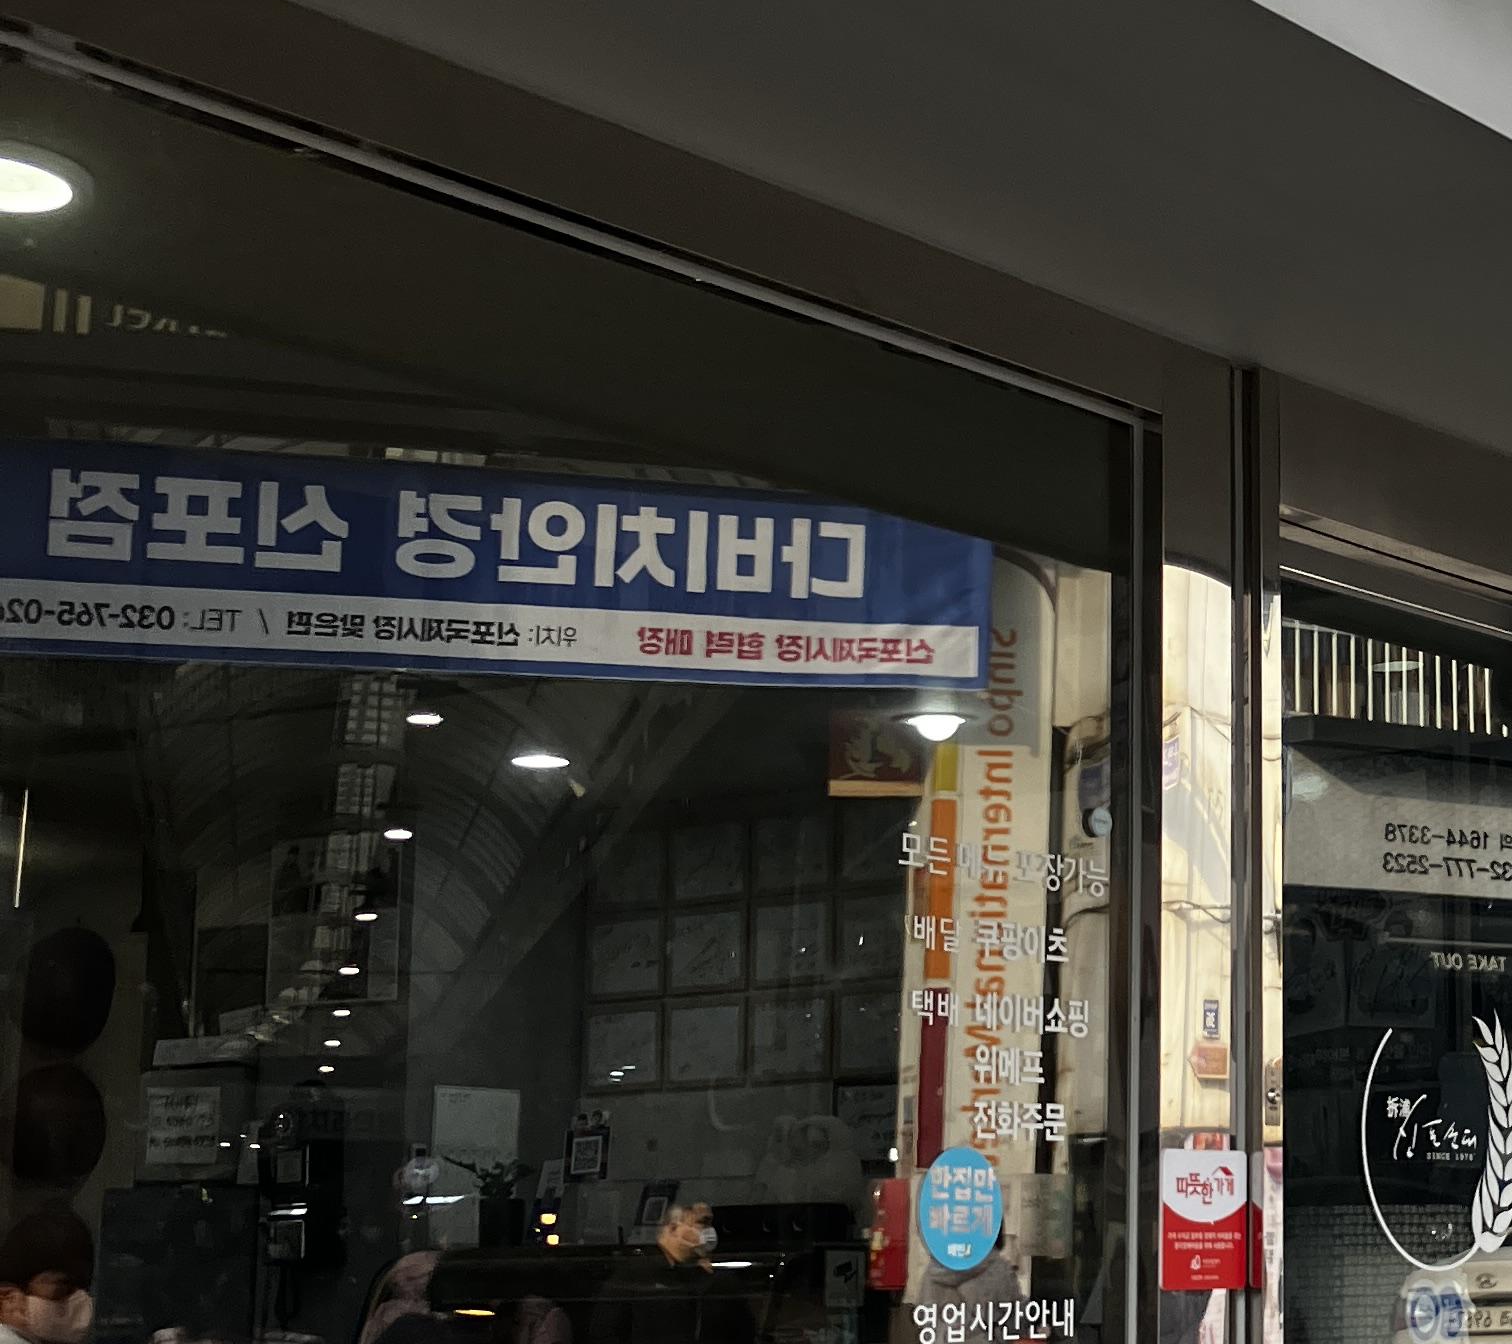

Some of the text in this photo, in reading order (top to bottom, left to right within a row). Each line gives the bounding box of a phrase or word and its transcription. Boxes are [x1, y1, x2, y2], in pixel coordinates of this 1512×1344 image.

[899, 832, 951, 876] 모든
[913, 915, 1069, 964] 배달 쿠팡이츠
[911, 990, 959, 1027] 택배
[973, 1044, 1045, 1087] 위메프
[973, 1100, 1067, 1142] 전화주문
[1176, 1172, 1235, 1205] 따뜻한 가게
